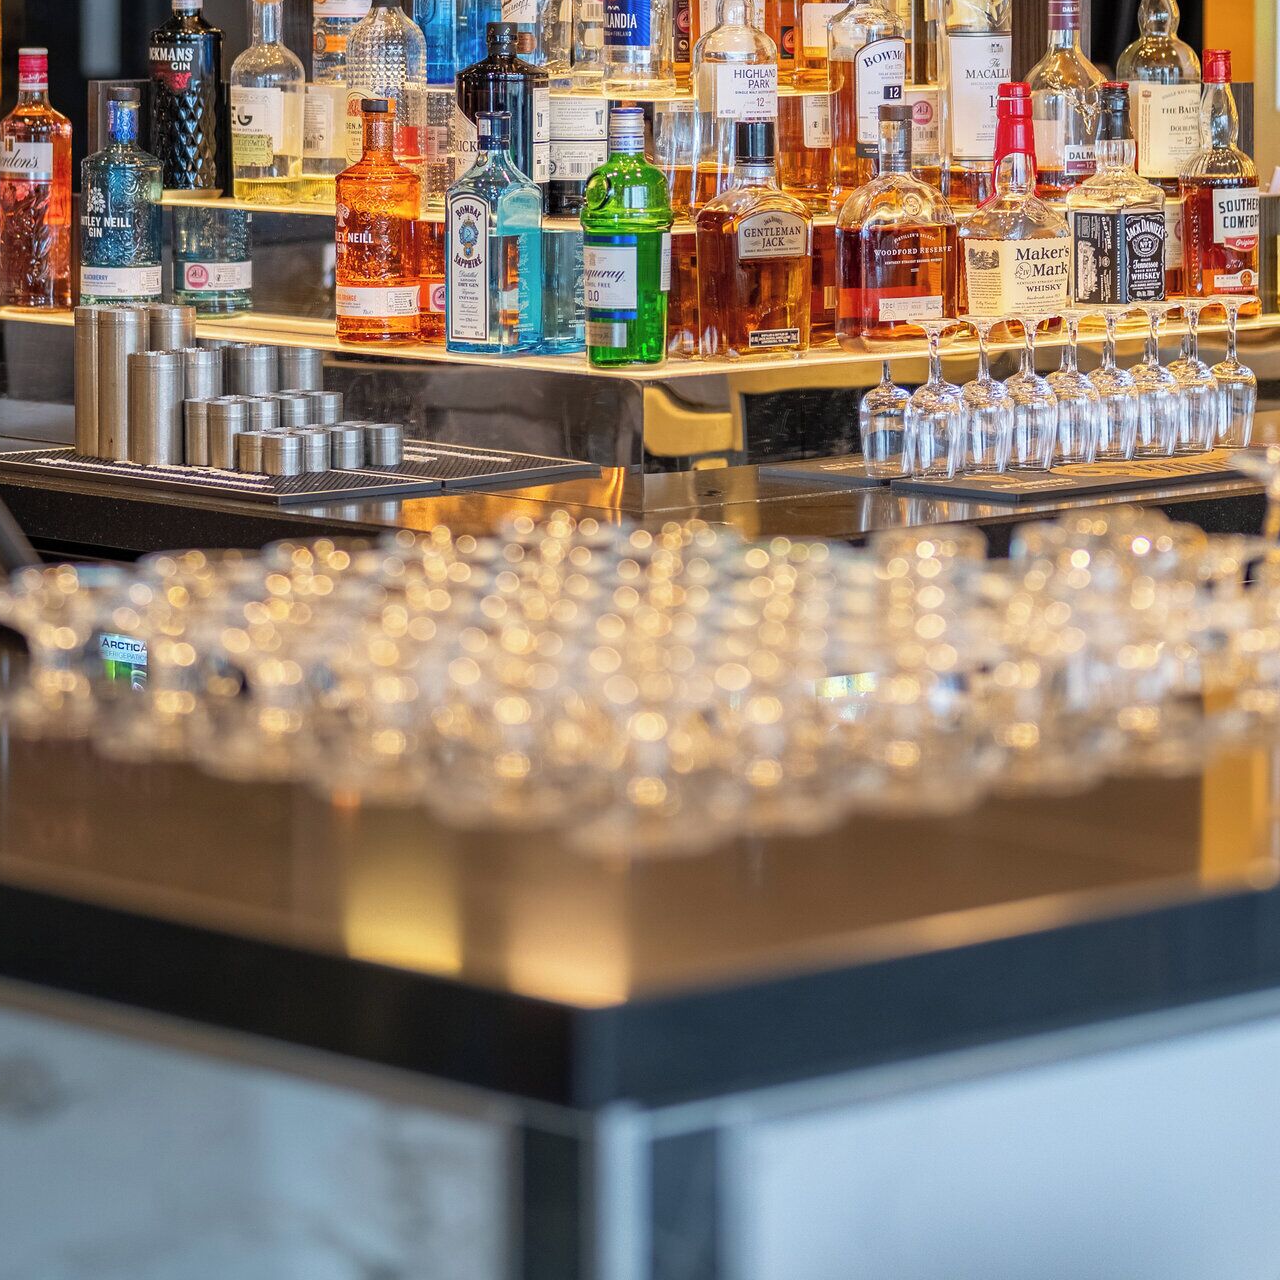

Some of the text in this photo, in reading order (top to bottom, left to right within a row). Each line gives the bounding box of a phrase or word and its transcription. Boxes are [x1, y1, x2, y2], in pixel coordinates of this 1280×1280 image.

[604, 13, 638, 29] LANDIA
[170, 62, 192, 71] GIN
[748, 79, 770, 89] PARK
[888, 86, 900, 99] 12
[755, 97, 765, 107] 12
[1184, 136, 1193, 145] 12
[1085, 161, 1094, 169] 12
[455, 204, 483, 221] BOMBAY
[103, 216, 132, 228] NEILL
[88, 227, 104, 238] GIN
[743, 225, 802, 238] GENTLEMAN
[1125, 218, 1166, 241] JACK DANIEL'S
[347, 232, 375, 244] NEILL
[761, 237, 785, 249] JACK
[1235, 238, 1257, 248] Original
[873, 245, 953, 256] WOODFORD RESERVE
[1015, 245, 1070, 261] Maker's
[453, 252, 484, 269] SAPPHIRE
[1132, 259, 1159, 270] Tennessee
[1031, 261, 1068, 277] Mark
[1131, 271, 1161, 280] WHISKEY
[1026, 283, 1062, 292] WHISKY
[587, 289, 600, 302] 0.0
[101, 637, 147, 652] ARCTICA
